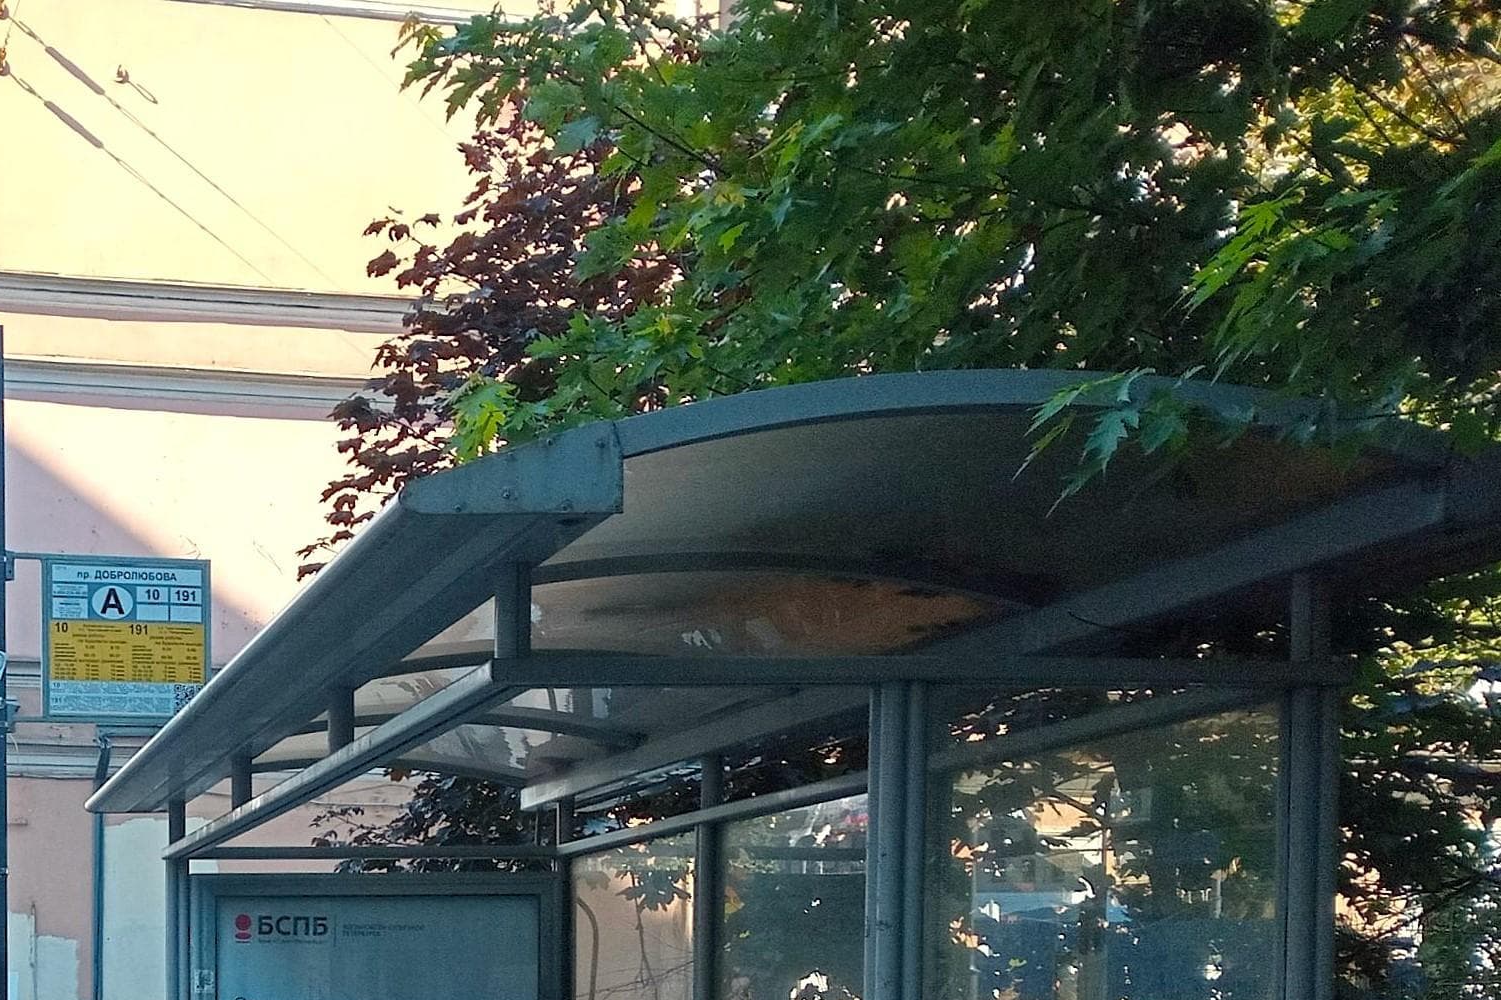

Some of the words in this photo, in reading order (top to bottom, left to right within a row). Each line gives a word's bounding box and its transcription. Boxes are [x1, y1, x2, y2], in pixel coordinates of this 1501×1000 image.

[94, 570, 177, 581] ДОБРОЛЮБОВА
[145, 589, 160, 600] 10
[175, 590, 197, 601] 191
[100, 588, 125, 615] А
[55, 622, 68, 633] 10
[129, 624, 148, 636] 191
[258, 915, 328, 936] БСПБ
